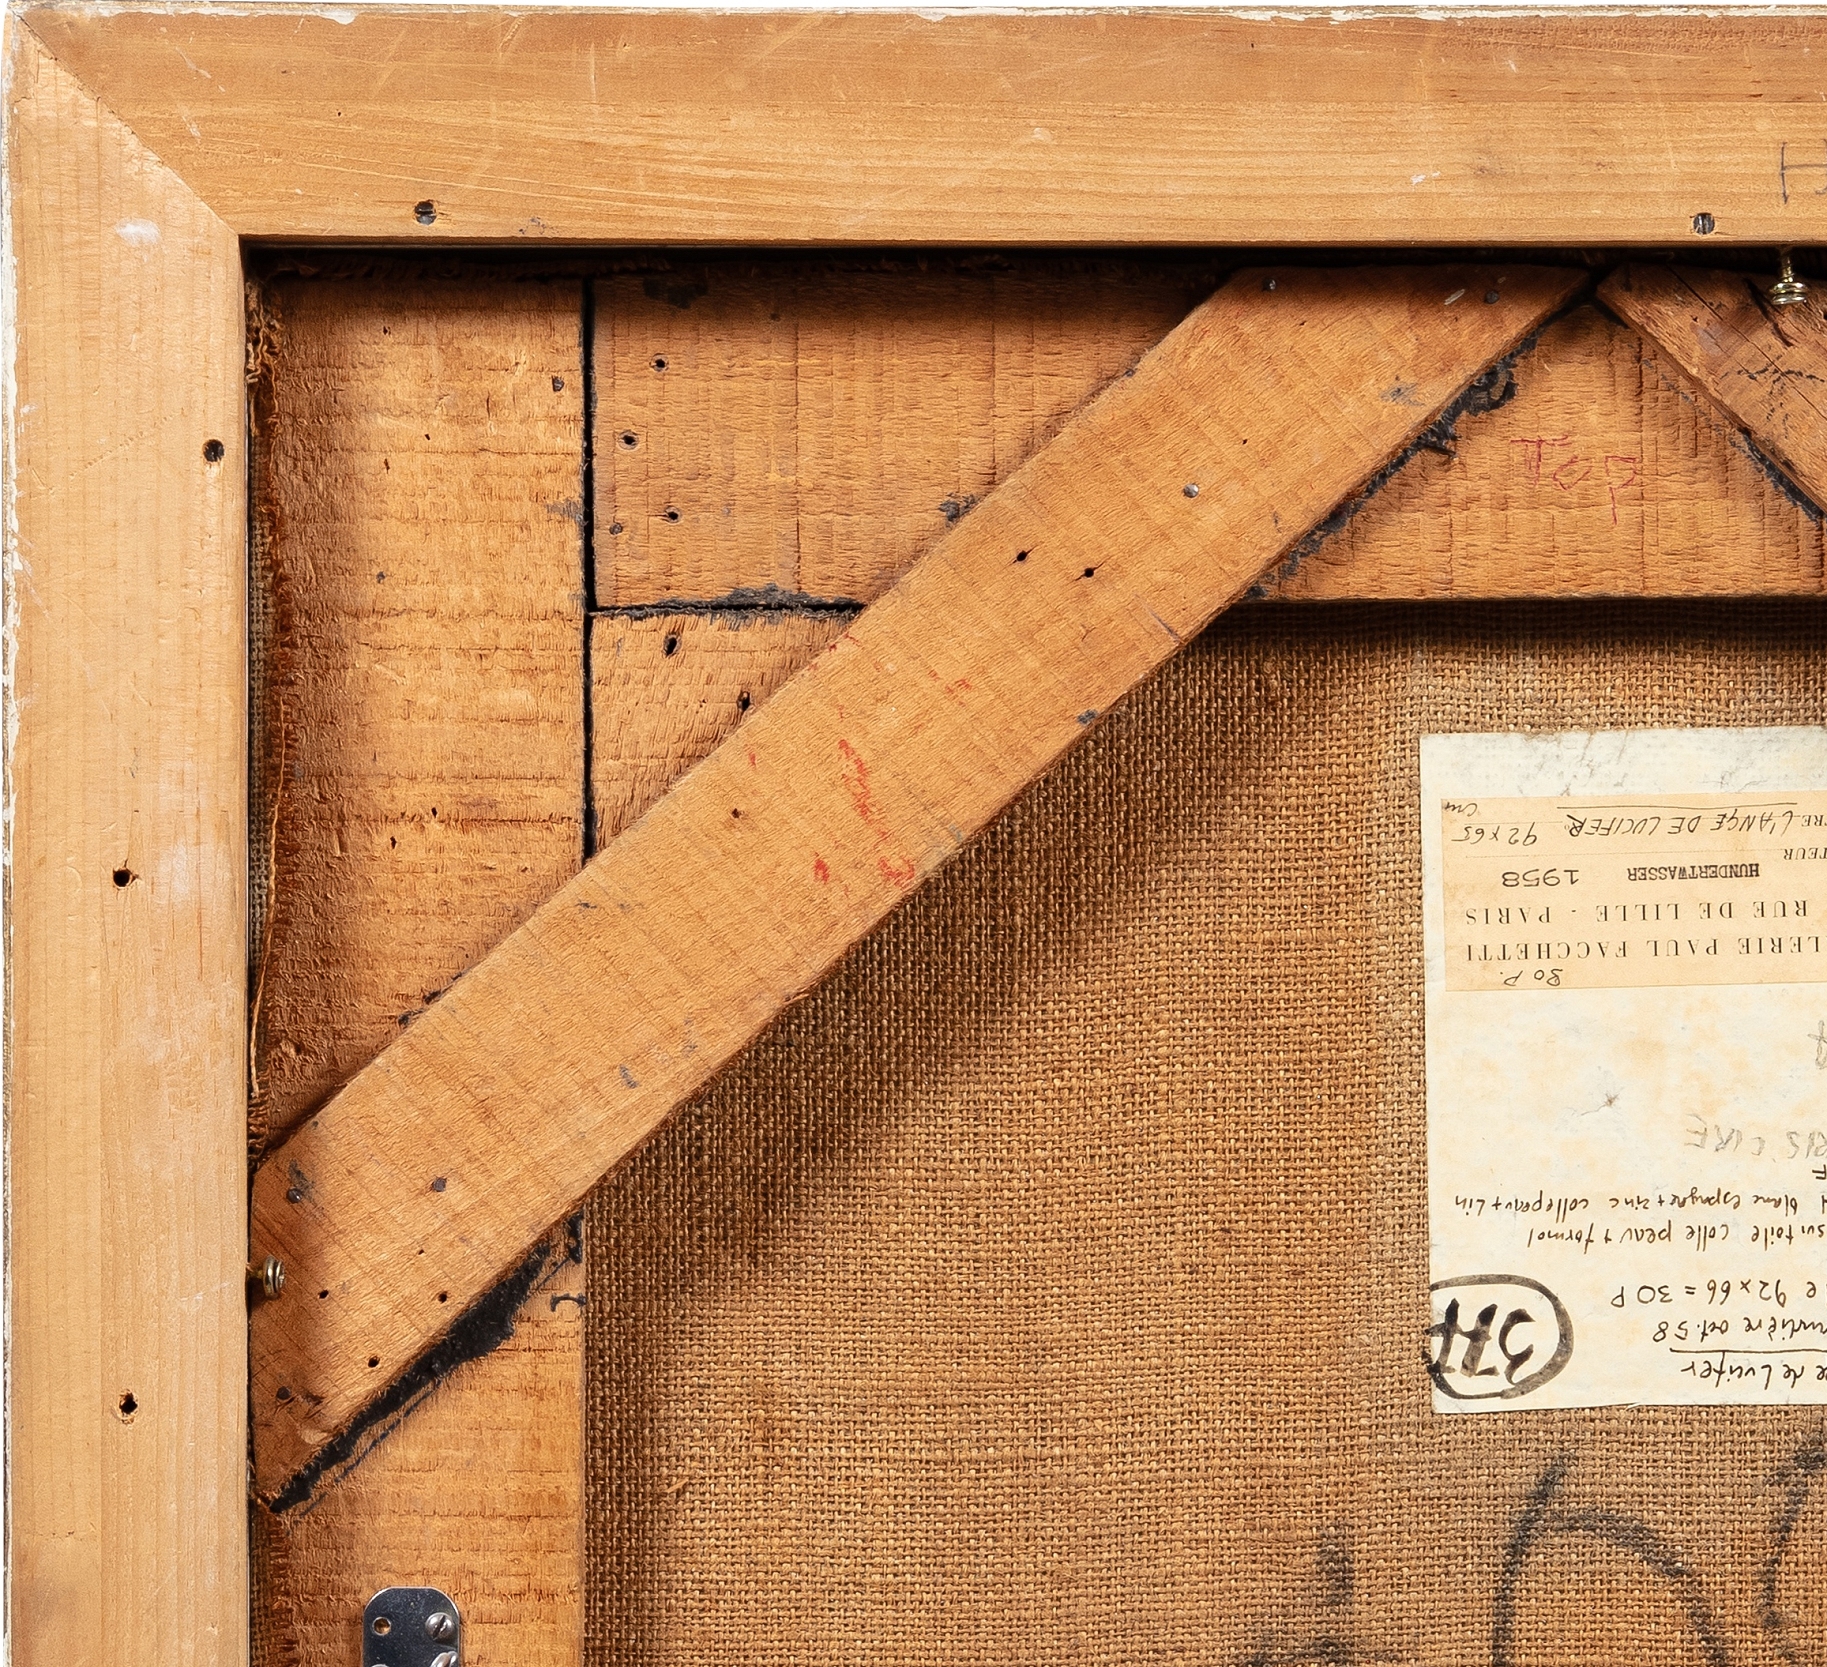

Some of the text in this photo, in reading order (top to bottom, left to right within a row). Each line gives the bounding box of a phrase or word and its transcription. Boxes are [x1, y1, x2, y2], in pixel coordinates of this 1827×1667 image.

[1566, 814, 1660, 838] LUCIFER
[1668, 816, 1701, 835] DE
[1500, 863, 1760, 888] HUNDERTWASSER 1958
[1463, 906, 1552, 925] PARIS
[1595, 902, 1679, 922] LILLE
[1698, 901, 1734, 920] DE
[1752, 899, 1809, 919] RUE
[1464, 940, 1628, 962] FACCHETTI
[1645, 937, 1718, 958] PAUL
[1685, 1224, 1729, 1251] colle
[1706, 1280, 1731, 1305] 66
[1759, 1279, 1787, 1307] 92
[1781, 1363, 1805, 1391] de
